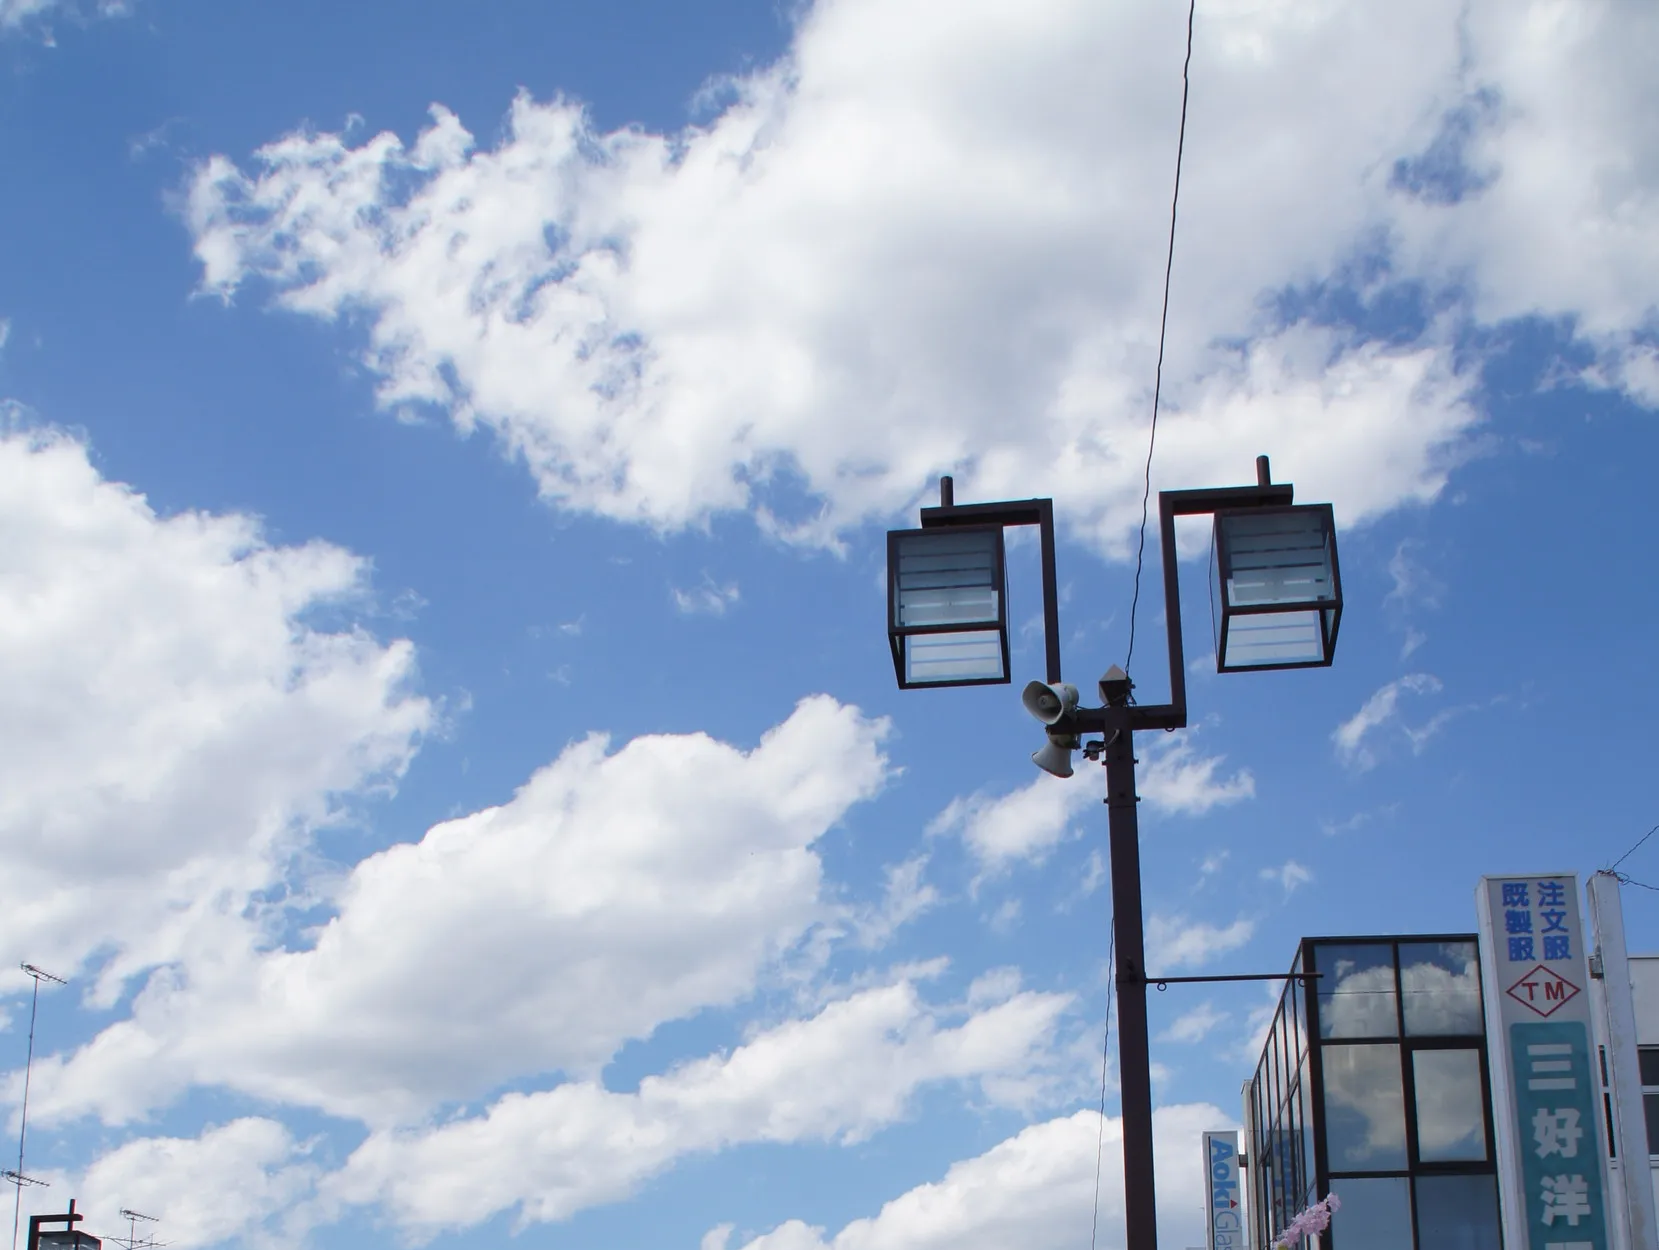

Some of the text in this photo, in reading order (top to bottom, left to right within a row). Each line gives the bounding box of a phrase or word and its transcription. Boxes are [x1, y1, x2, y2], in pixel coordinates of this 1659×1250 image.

[1501, 882, 1536, 962] 既製服
[1537, 881, 1571, 961] 注文服
[1521, 981, 1566, 1001] TM
